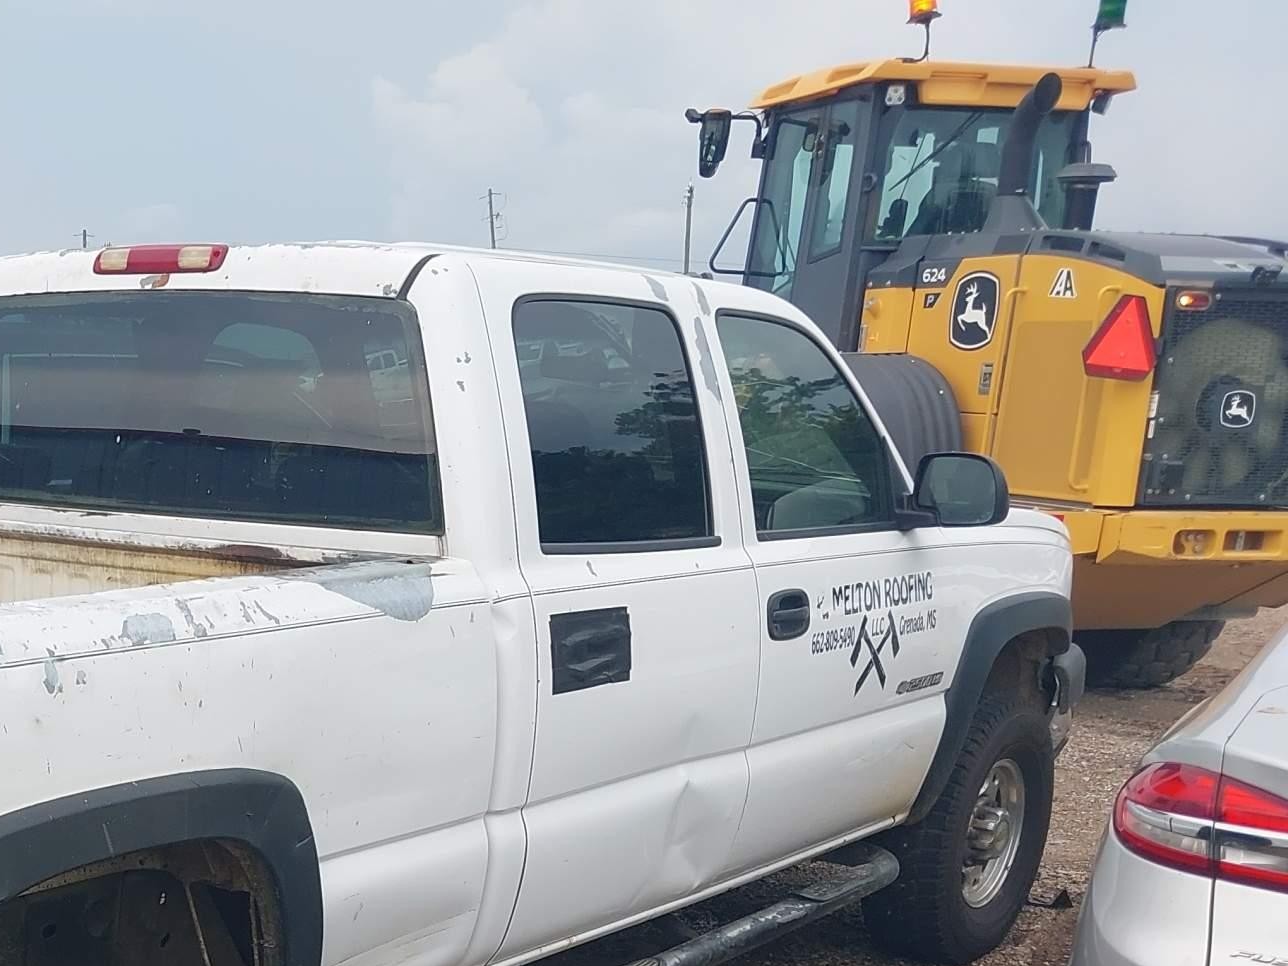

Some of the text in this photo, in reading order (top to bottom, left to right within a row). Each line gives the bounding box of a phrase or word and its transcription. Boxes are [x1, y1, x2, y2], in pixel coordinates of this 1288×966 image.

[922, 268, 947, 283] 624
[832, 580, 881, 616] MELTON
[884, 571, 933, 608] ROOFING
[811, 609, 937, 656] 662-809-5490 LLC Grenada, MS
